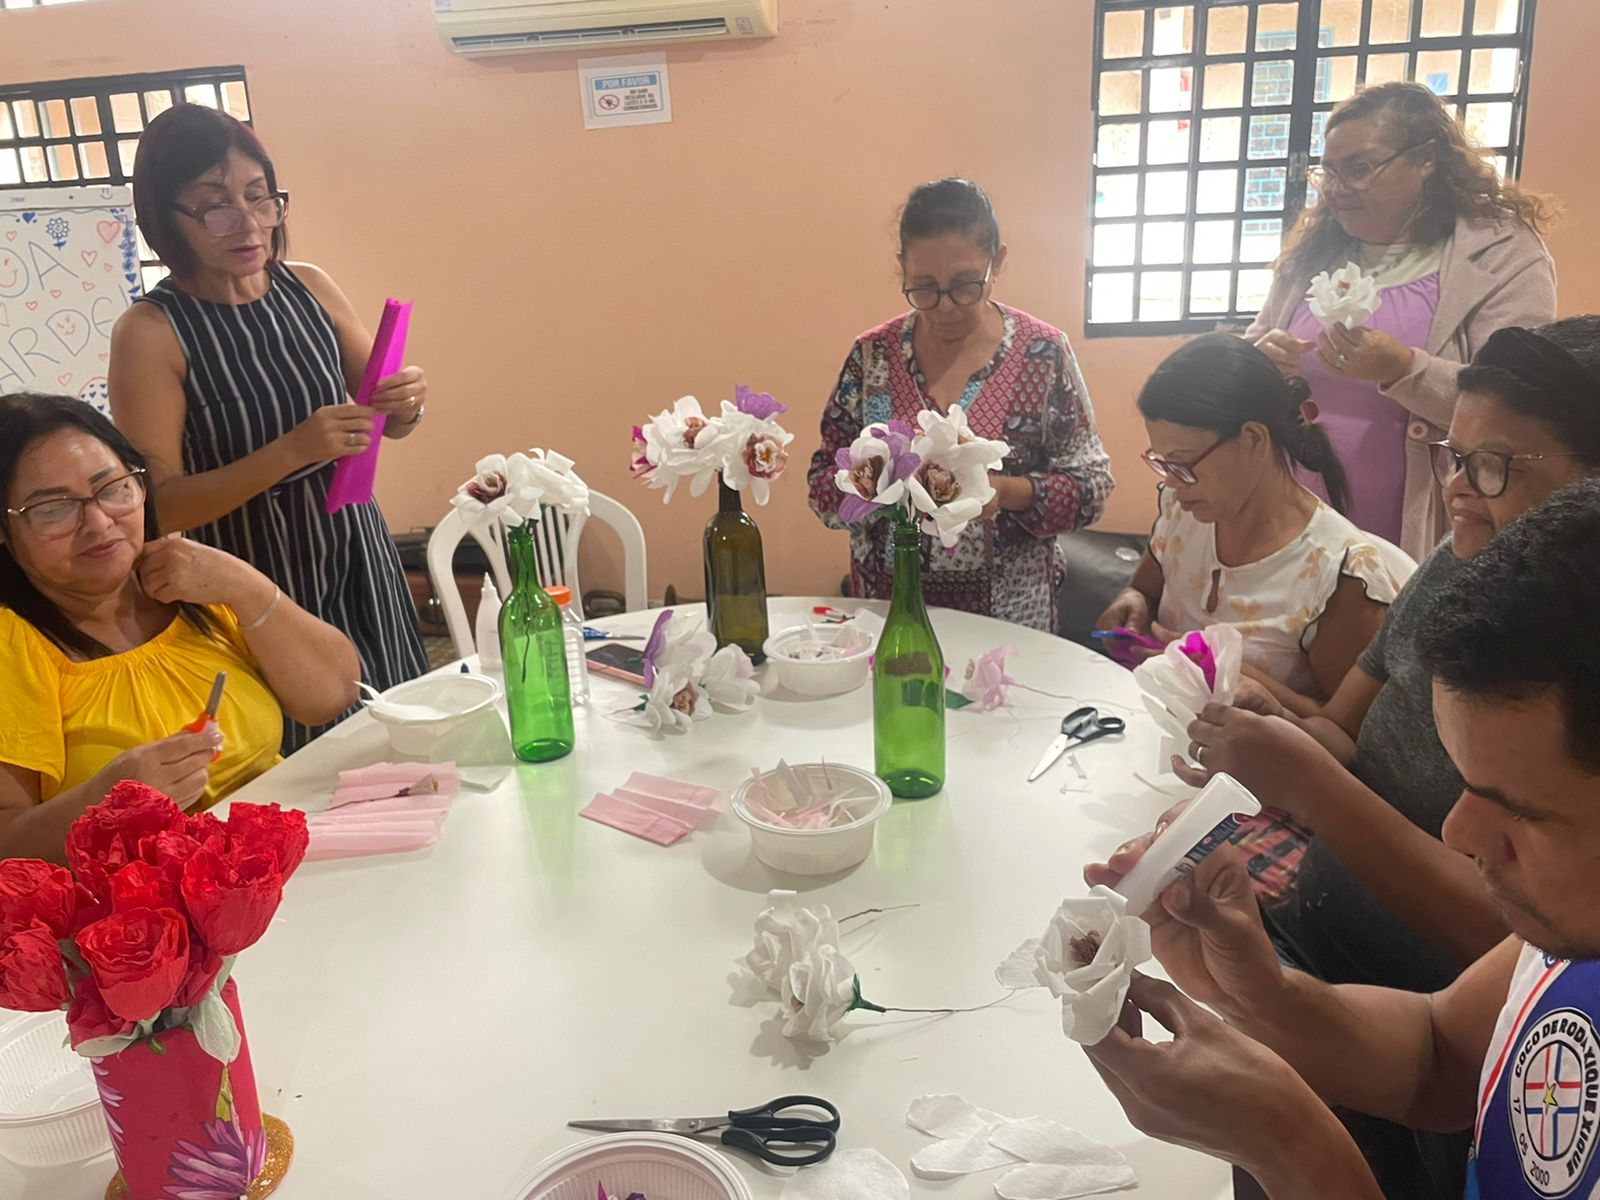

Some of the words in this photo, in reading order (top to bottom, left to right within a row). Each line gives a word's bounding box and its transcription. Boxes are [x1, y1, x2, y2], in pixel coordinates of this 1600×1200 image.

[602, 79, 619, 89] POR
[621, 76, 650, 88] FAVOR
[0, 241, 79, 298] OA
[1515, 1031, 1540, 1078] COCO
[1542, 1019, 1559, 1039] DE
[1566, 1119, 1594, 1178] XIQUE
[1513, 1097, 1522, 1114] 17
[1530, 1161, 1550, 1186] 2000
